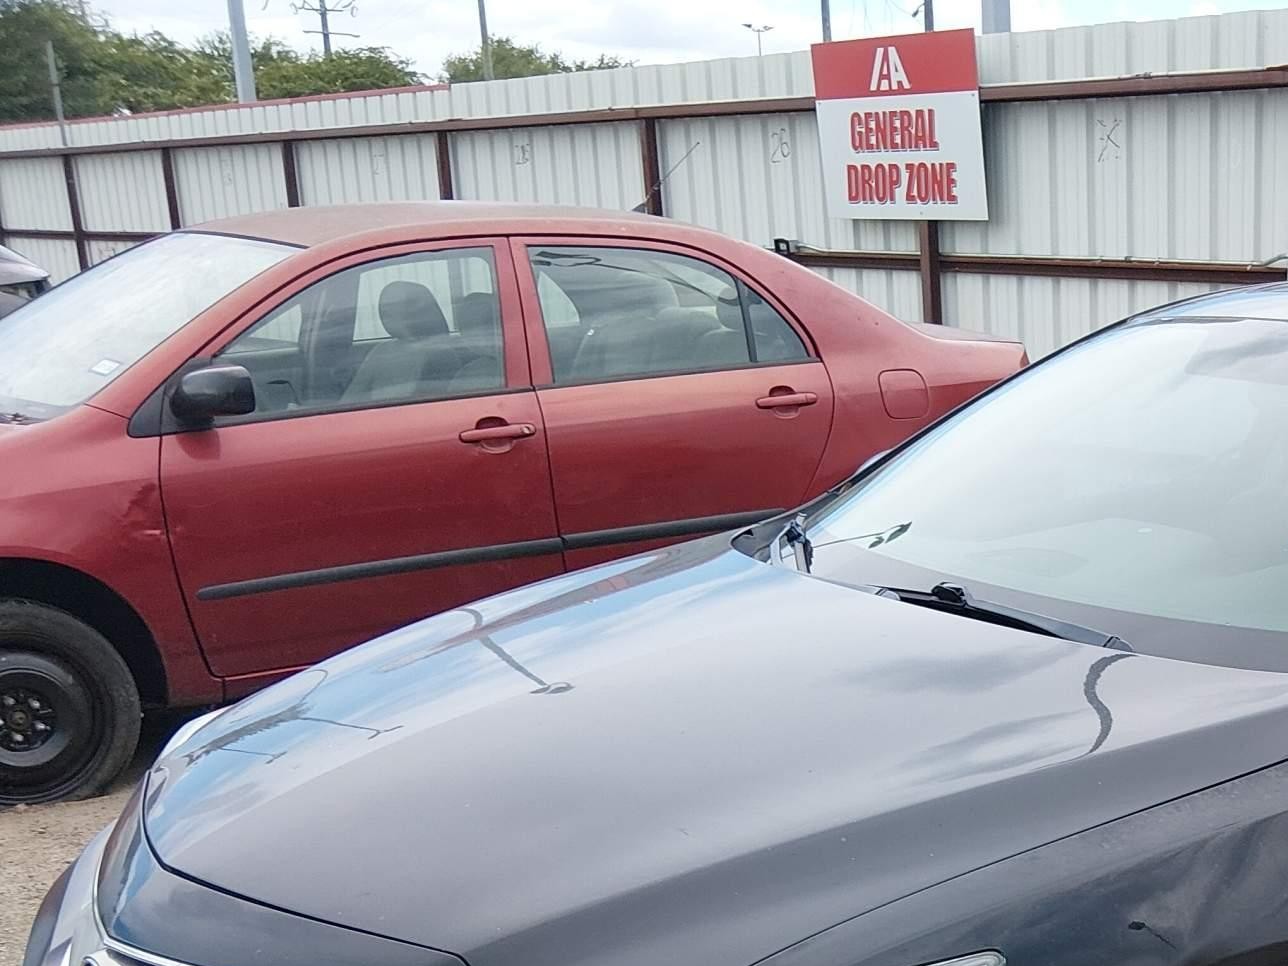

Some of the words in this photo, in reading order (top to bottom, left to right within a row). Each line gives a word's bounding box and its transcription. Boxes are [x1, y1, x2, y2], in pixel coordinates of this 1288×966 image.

[850, 108, 940, 153] GENERAL
[846, 163, 902, 205] DROP
[905, 162, 959, 205] ZONE
